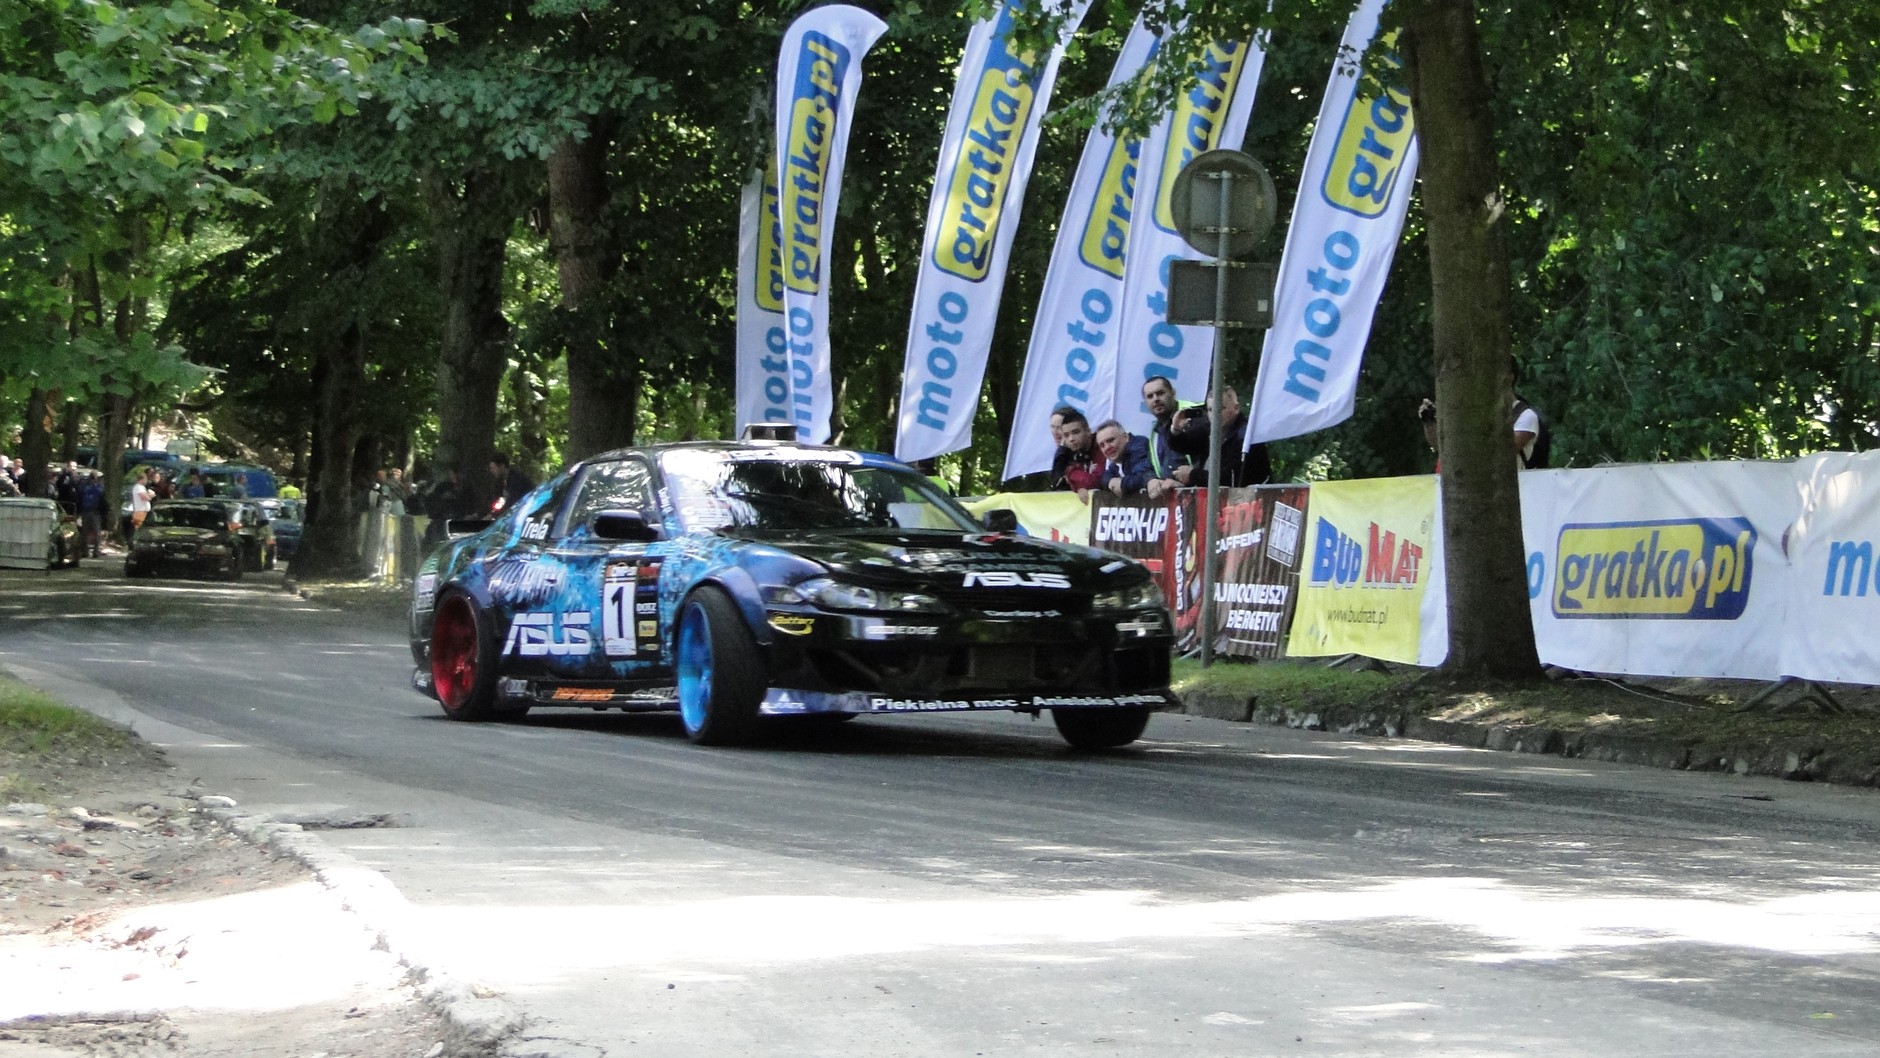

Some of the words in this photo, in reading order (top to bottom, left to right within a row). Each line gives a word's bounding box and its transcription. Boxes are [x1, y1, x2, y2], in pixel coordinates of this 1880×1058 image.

[790, 40, 838, 284] gratka.pl
[1283, 230, 1360, 404] moto
[917, 291, 969, 431] moto
[521, 517, 549, 539] Trela
[1095, 507, 1169, 542] GREEN-UP
[963, 571, 1072, 589] ASUS
[1558, 530, 1751, 609] gratka.pl
[502, 611, 592, 656] ASUS
[611, 586, 624, 639] 1
[871, 697, 970, 711] Piekielna
[973, 699, 1020, 709] moc
